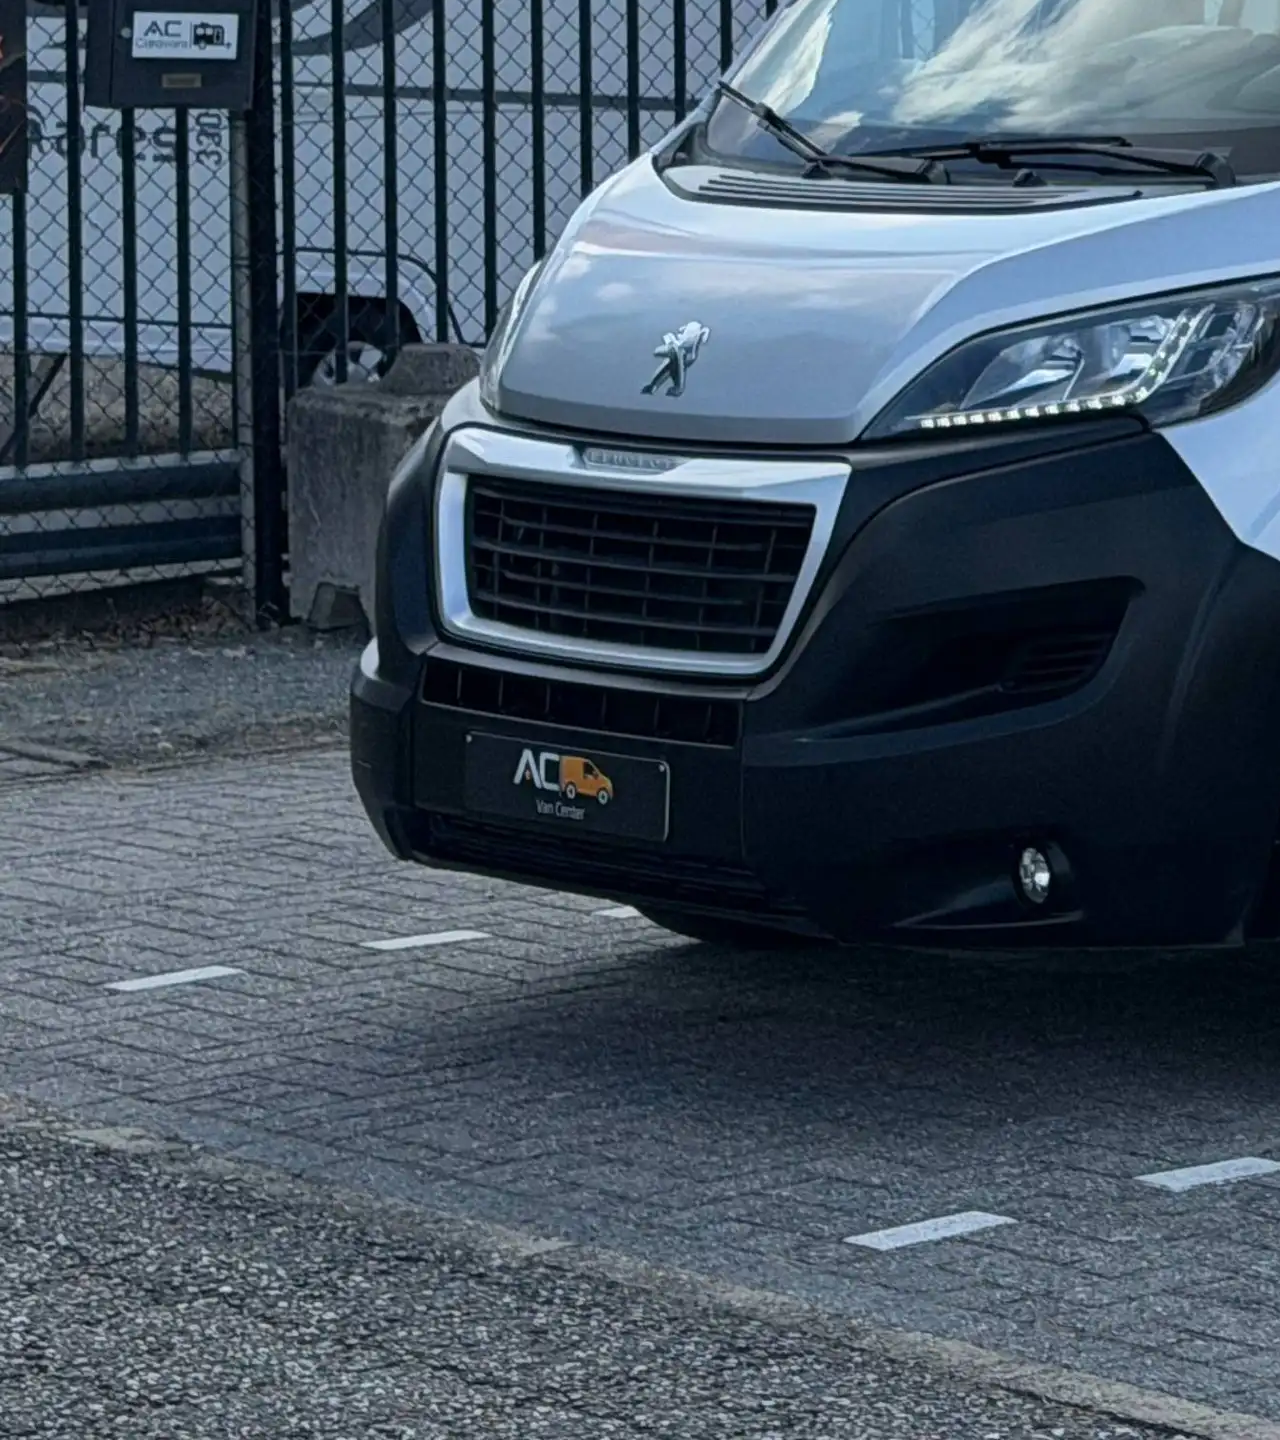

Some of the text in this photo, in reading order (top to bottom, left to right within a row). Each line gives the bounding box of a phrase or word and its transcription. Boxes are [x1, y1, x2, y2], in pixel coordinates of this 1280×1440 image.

[143, 20, 183, 37] AC
[512, 748, 560, 791] AC
[535, 799, 554, 814] Van
